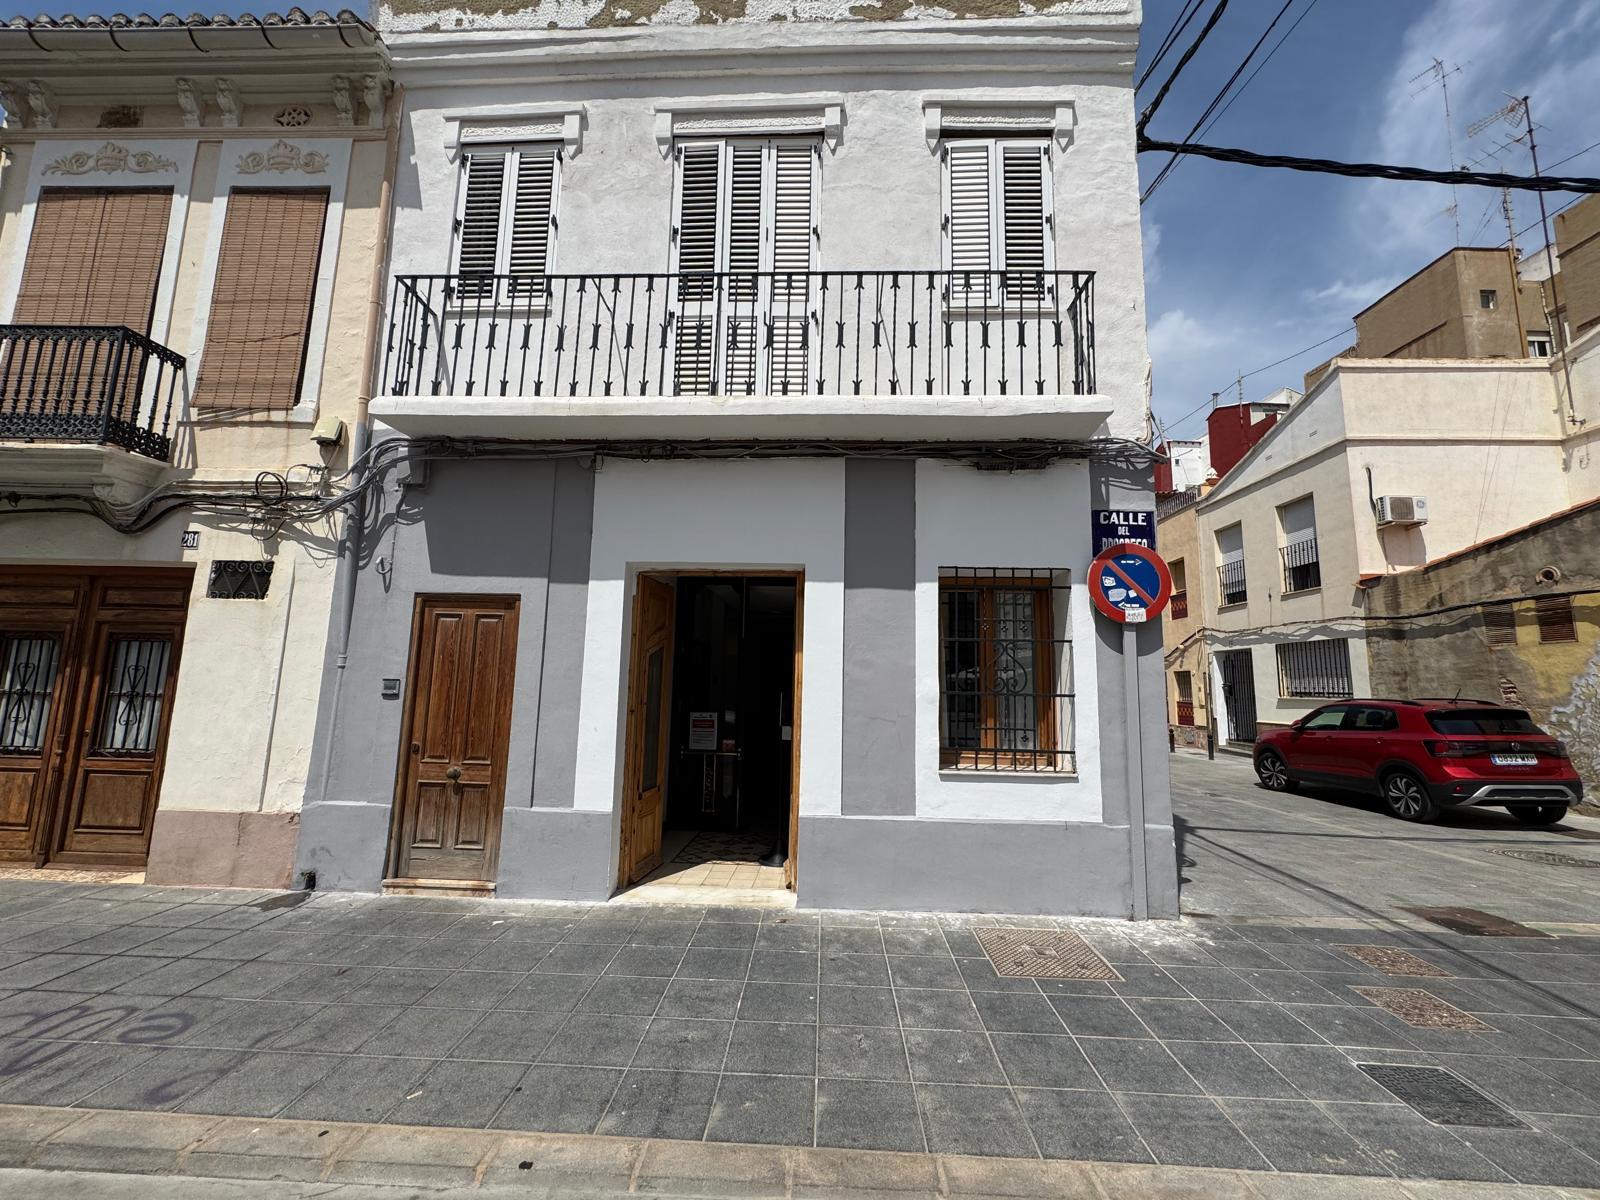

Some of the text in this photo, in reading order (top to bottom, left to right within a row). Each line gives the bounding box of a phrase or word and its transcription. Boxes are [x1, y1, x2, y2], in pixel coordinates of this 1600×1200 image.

[1100, 512, 1147, 525] CALLE
[1118, 526, 1130, 535] DEL
[182, 532, 199, 547] 281
